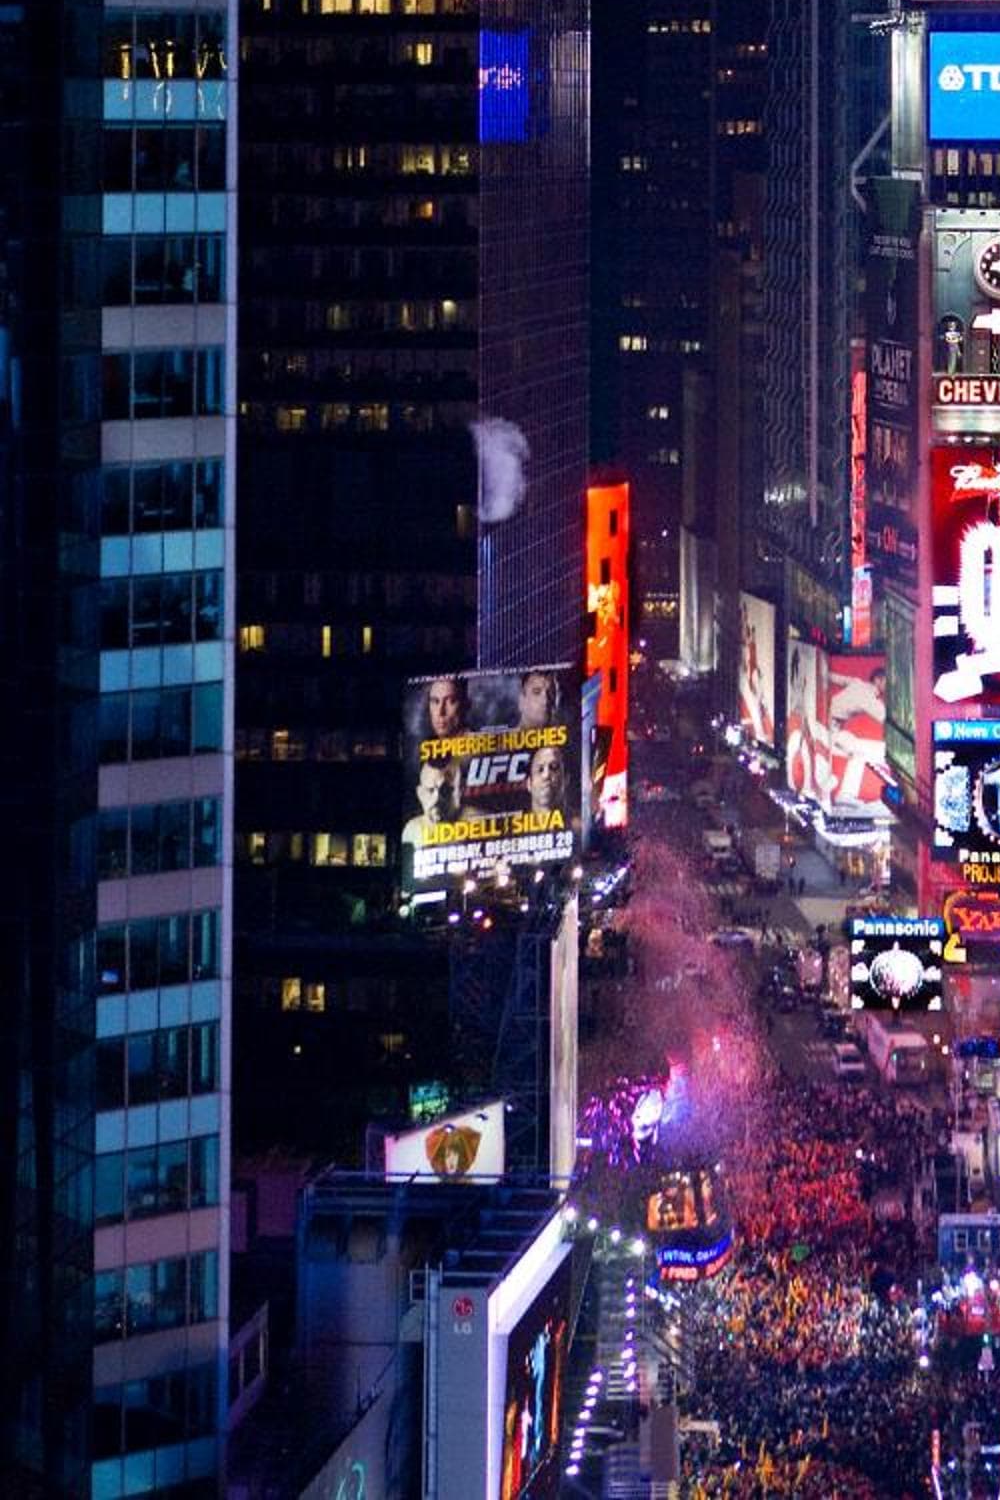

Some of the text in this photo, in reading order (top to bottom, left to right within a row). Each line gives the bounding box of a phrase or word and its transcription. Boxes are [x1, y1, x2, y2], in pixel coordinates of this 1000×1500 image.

[420, 725, 568, 760] ST-PIERRE HUGHES
[955, 724, 988, 740] News
[466, 753, 531, 787] UFC
[423, 809, 565, 845] LIDDELL SILVA
[485, 834, 554, 856] DECEMBER
[853, 920, 939, 936] Panasonic
[453, 1323, 472, 1335] LG
